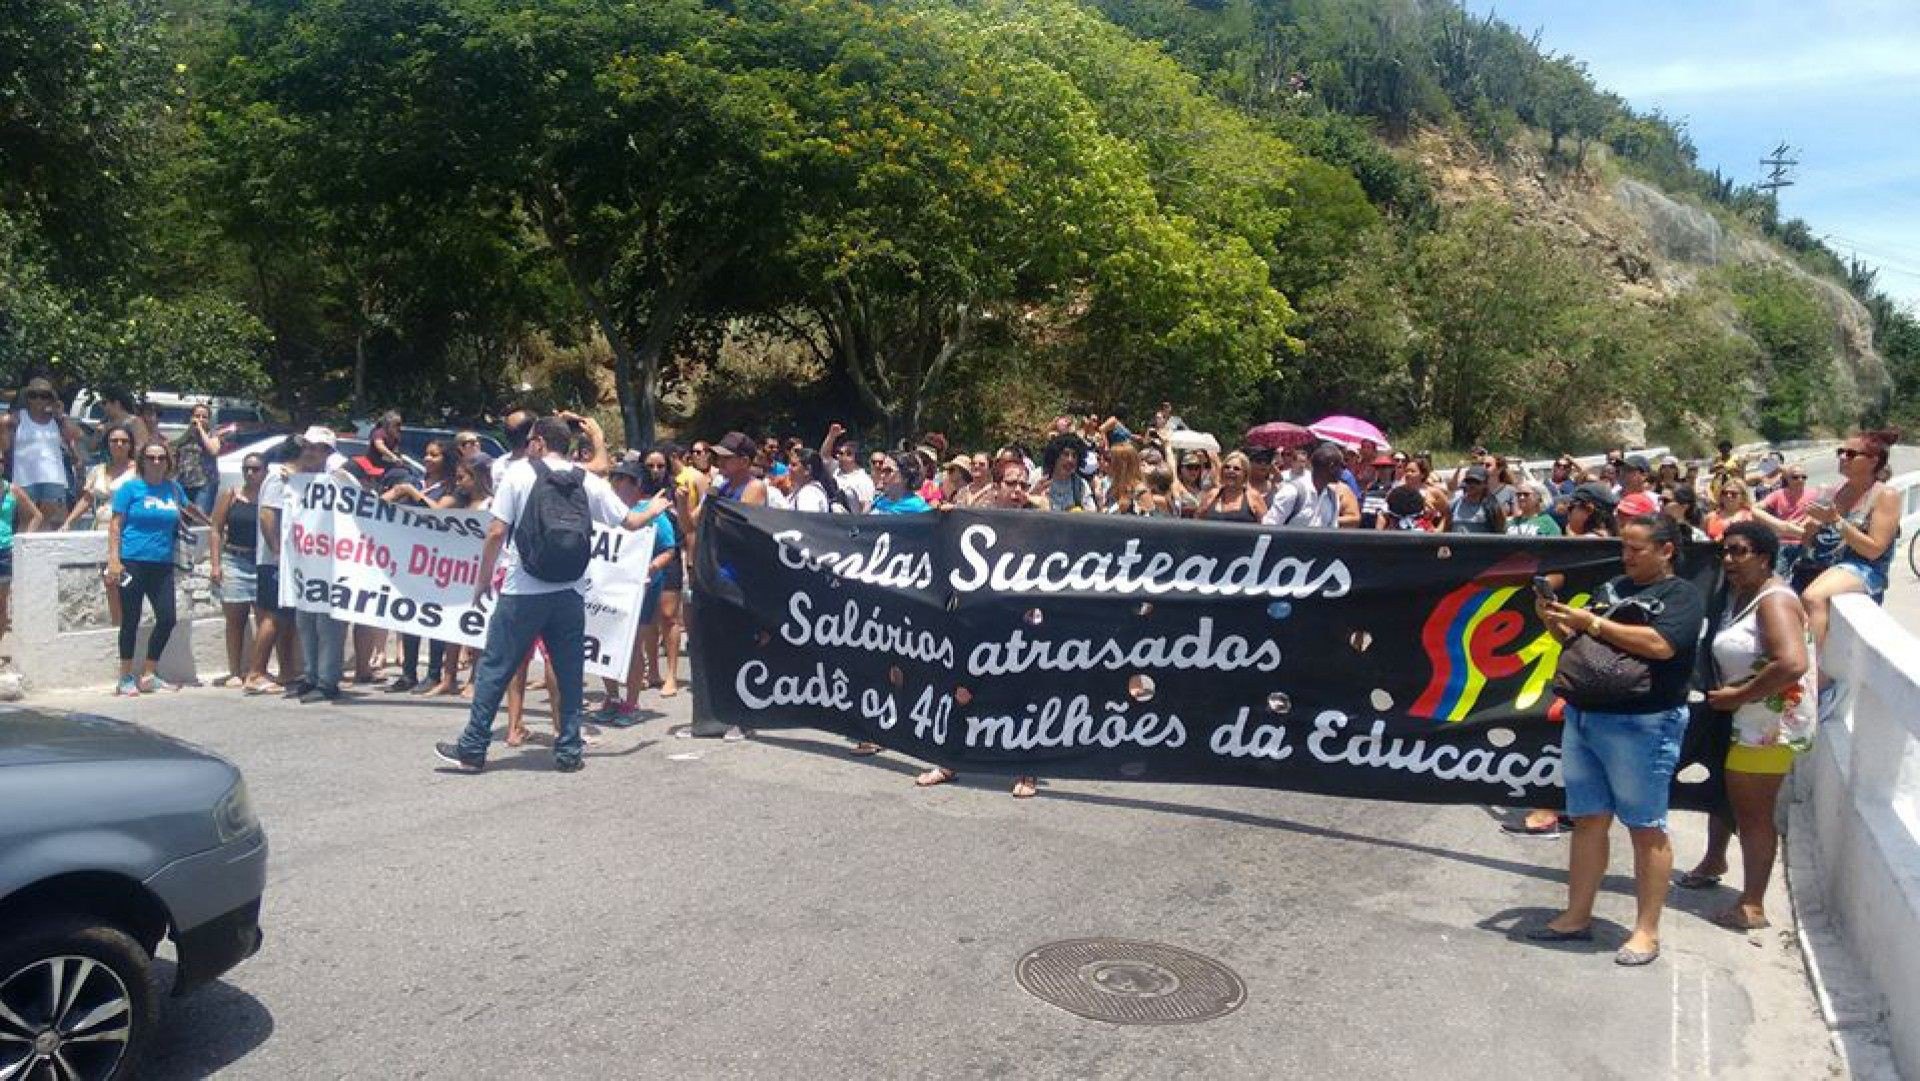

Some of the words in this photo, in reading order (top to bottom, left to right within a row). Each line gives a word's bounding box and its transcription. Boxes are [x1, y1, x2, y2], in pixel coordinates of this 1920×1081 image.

[292, 522, 397, 578] Reseito,
[949, 524, 1352, 598] Sucateadas
[293, 568, 443, 627] Saários
[780, 591, 954, 668] Salários
[968, 616, 1281, 676] atrasados
[736, 660, 853, 711] Cadê
[861, 688, 897, 730] os
[909, 685, 953, 745] 40
[965, 694, 1187, 751] milhões
[1210, 706, 1293, 760] da
[1306, 709, 1566, 797] Educaçã
